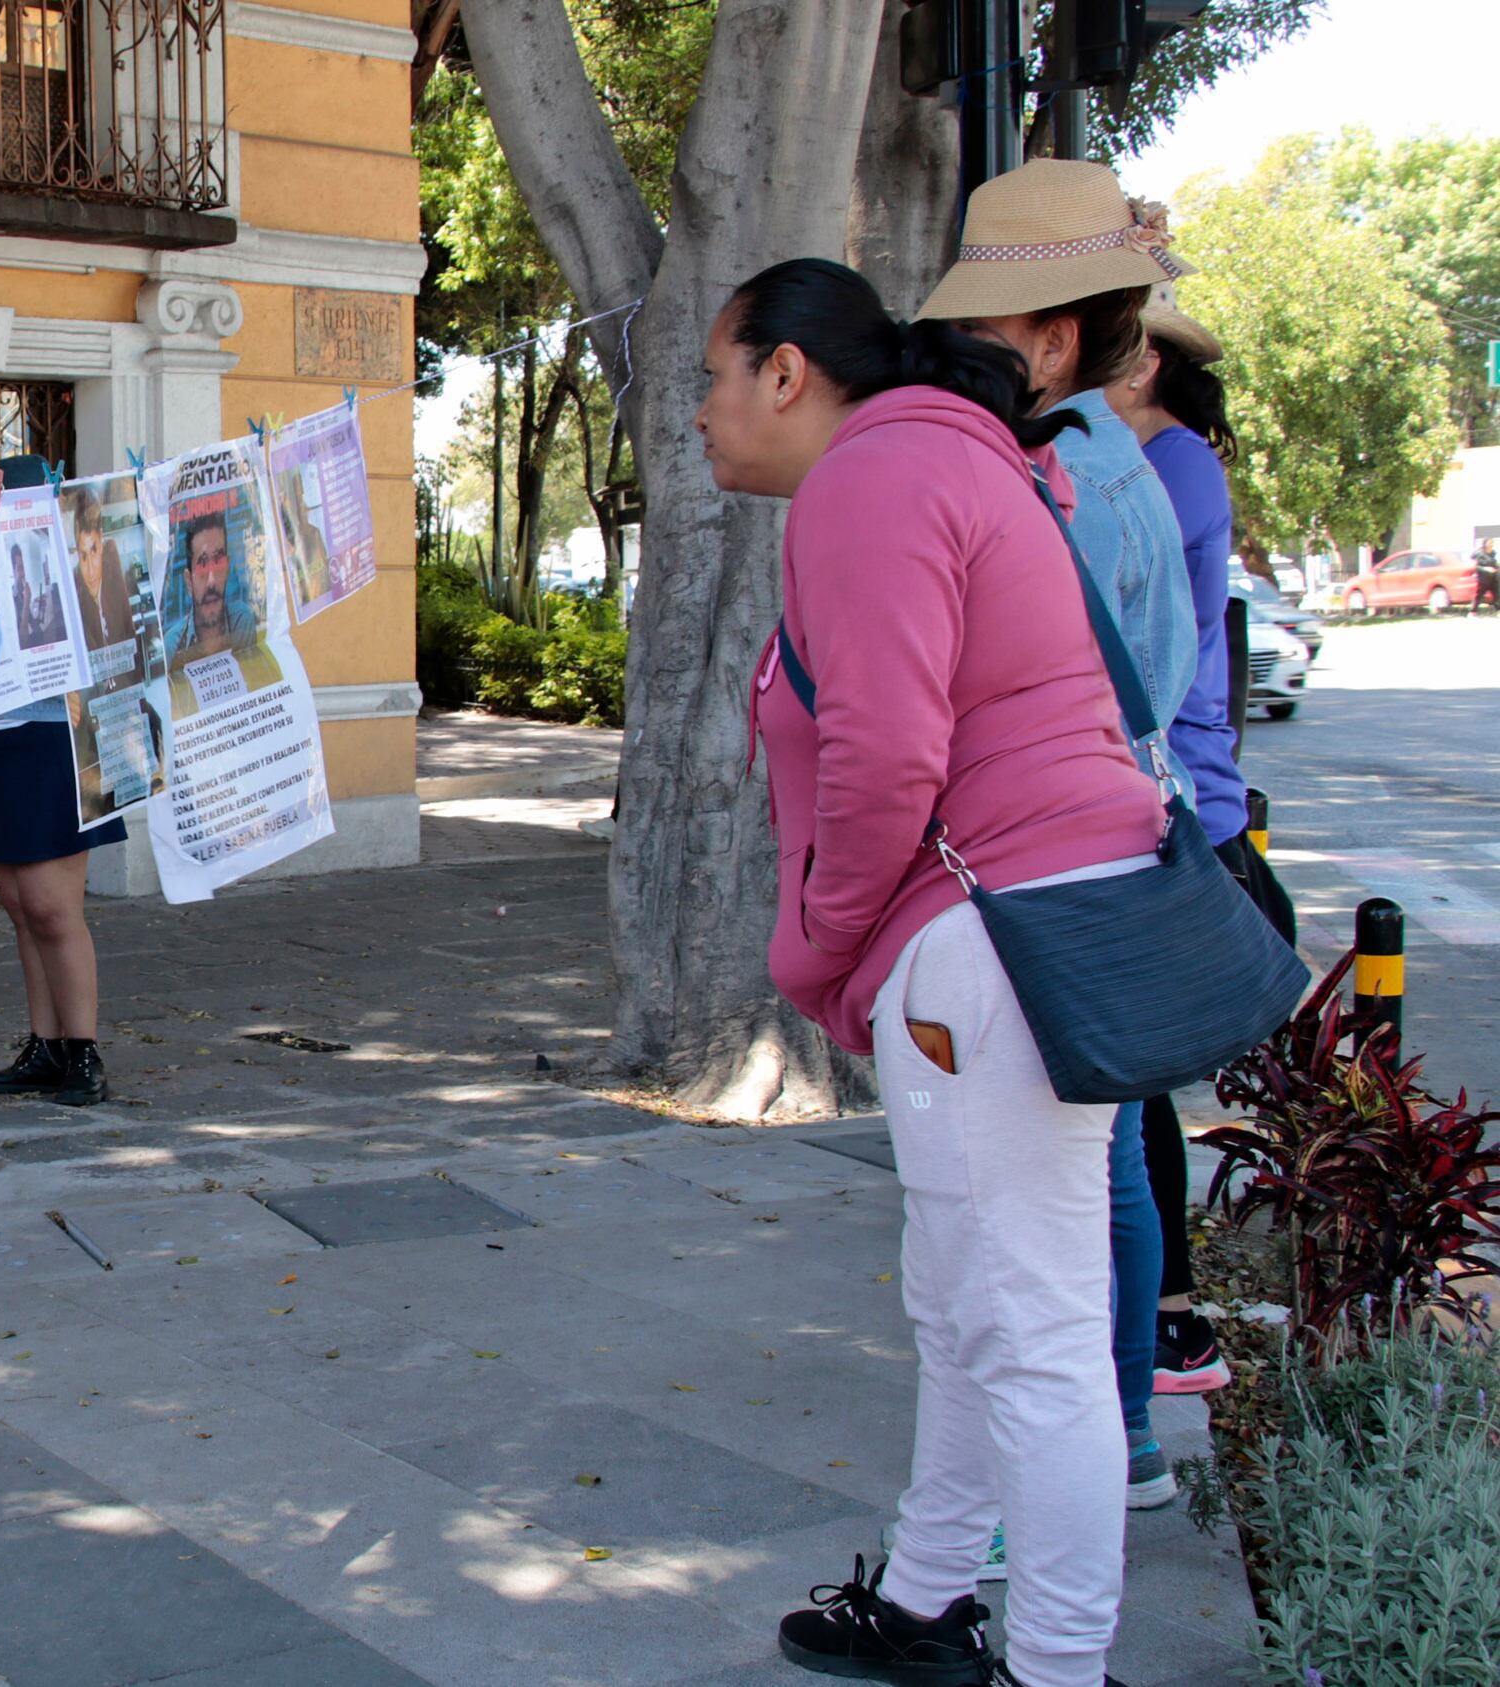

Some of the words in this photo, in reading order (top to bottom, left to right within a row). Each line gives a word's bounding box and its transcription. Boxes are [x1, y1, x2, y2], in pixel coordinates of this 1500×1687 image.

[195, 706, 239, 731] ABANDONADAS
[239, 700, 258, 714] DESDE
[258, 694, 273, 706] HACE
[274, 721, 285, 732] POR
[286, 716, 293, 726] SU
[179, 788, 194, 799] QUE
